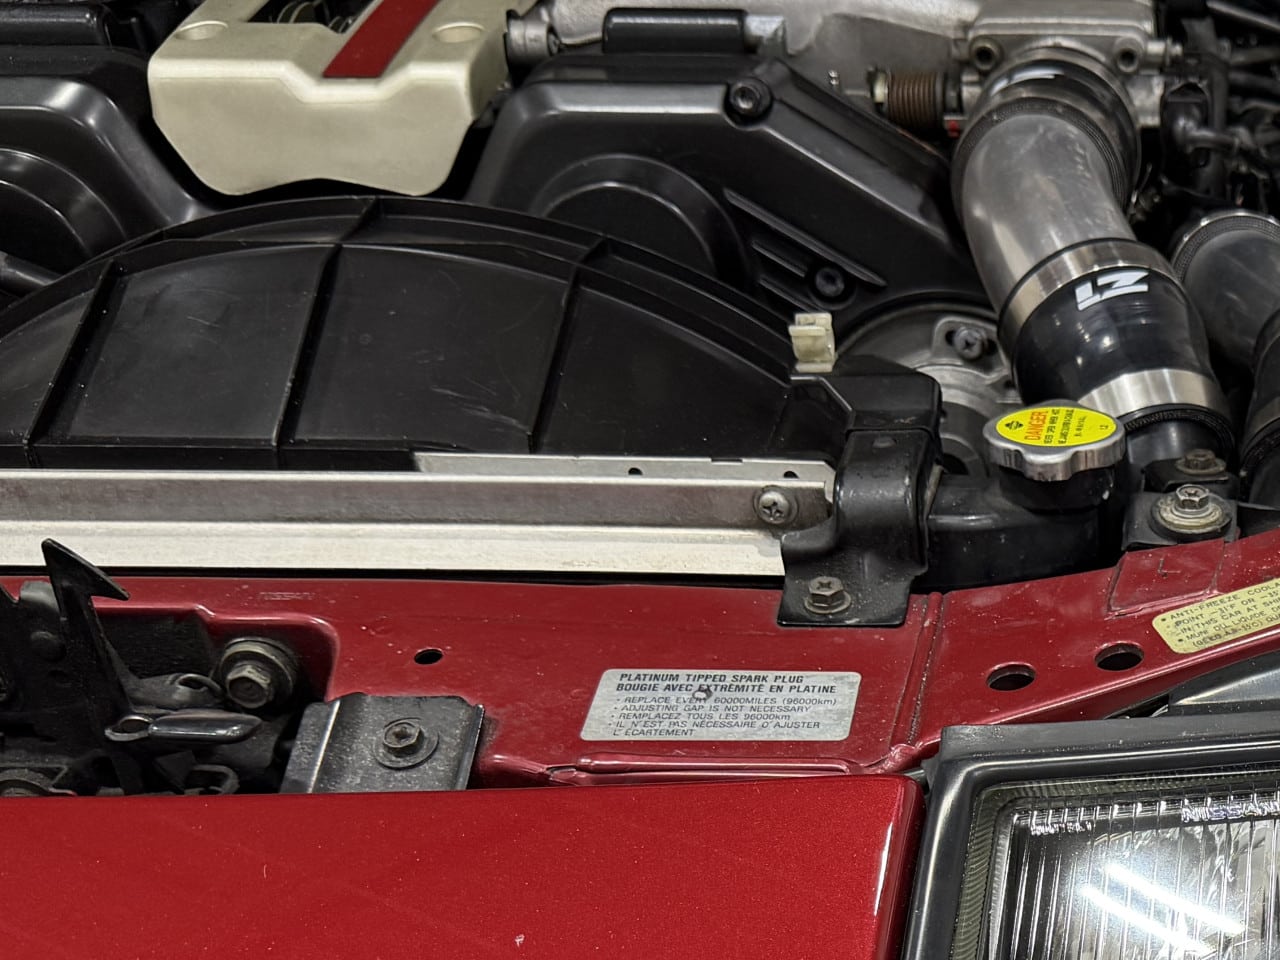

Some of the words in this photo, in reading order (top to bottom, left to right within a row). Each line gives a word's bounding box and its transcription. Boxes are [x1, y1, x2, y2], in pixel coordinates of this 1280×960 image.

[1024, 411, 1048, 441] DANGER
[1170, 594, 1240, 620] ANTI-FREEZE
[1175, 613, 1204, 627] POINT
[1241, 597, 1255, 606] OR
[1196, 618, 1218, 628] THIS
[1221, 610, 1242, 621] CAR
[1247, 604, 1259, 613] AT
[1232, 611, 1267, 626] LIQUIDE
[619, 673, 680, 682] PLATINUM
[686, 674, 726, 683] TIPPED
[731, 674, 768, 683] SPARK
[774, 675, 804, 684] PLUG
[616, 683, 659, 692] BOUGIE
[664, 684, 693, 692] AVEC
[769, 685, 783, 693] EN
[789, 685, 837, 694] PLATINE
[624, 696, 670, 704] REPLACE
[675, 696, 707, 704] EVERY
[714, 697, 777, 705] 60000MILES
[782, 697, 837, 706] (96000km)
[621, 704, 678, 712] ADJUSTING
[749, 705, 811, 713] NECESSARY
[743, 713, 791, 721] 96000km
